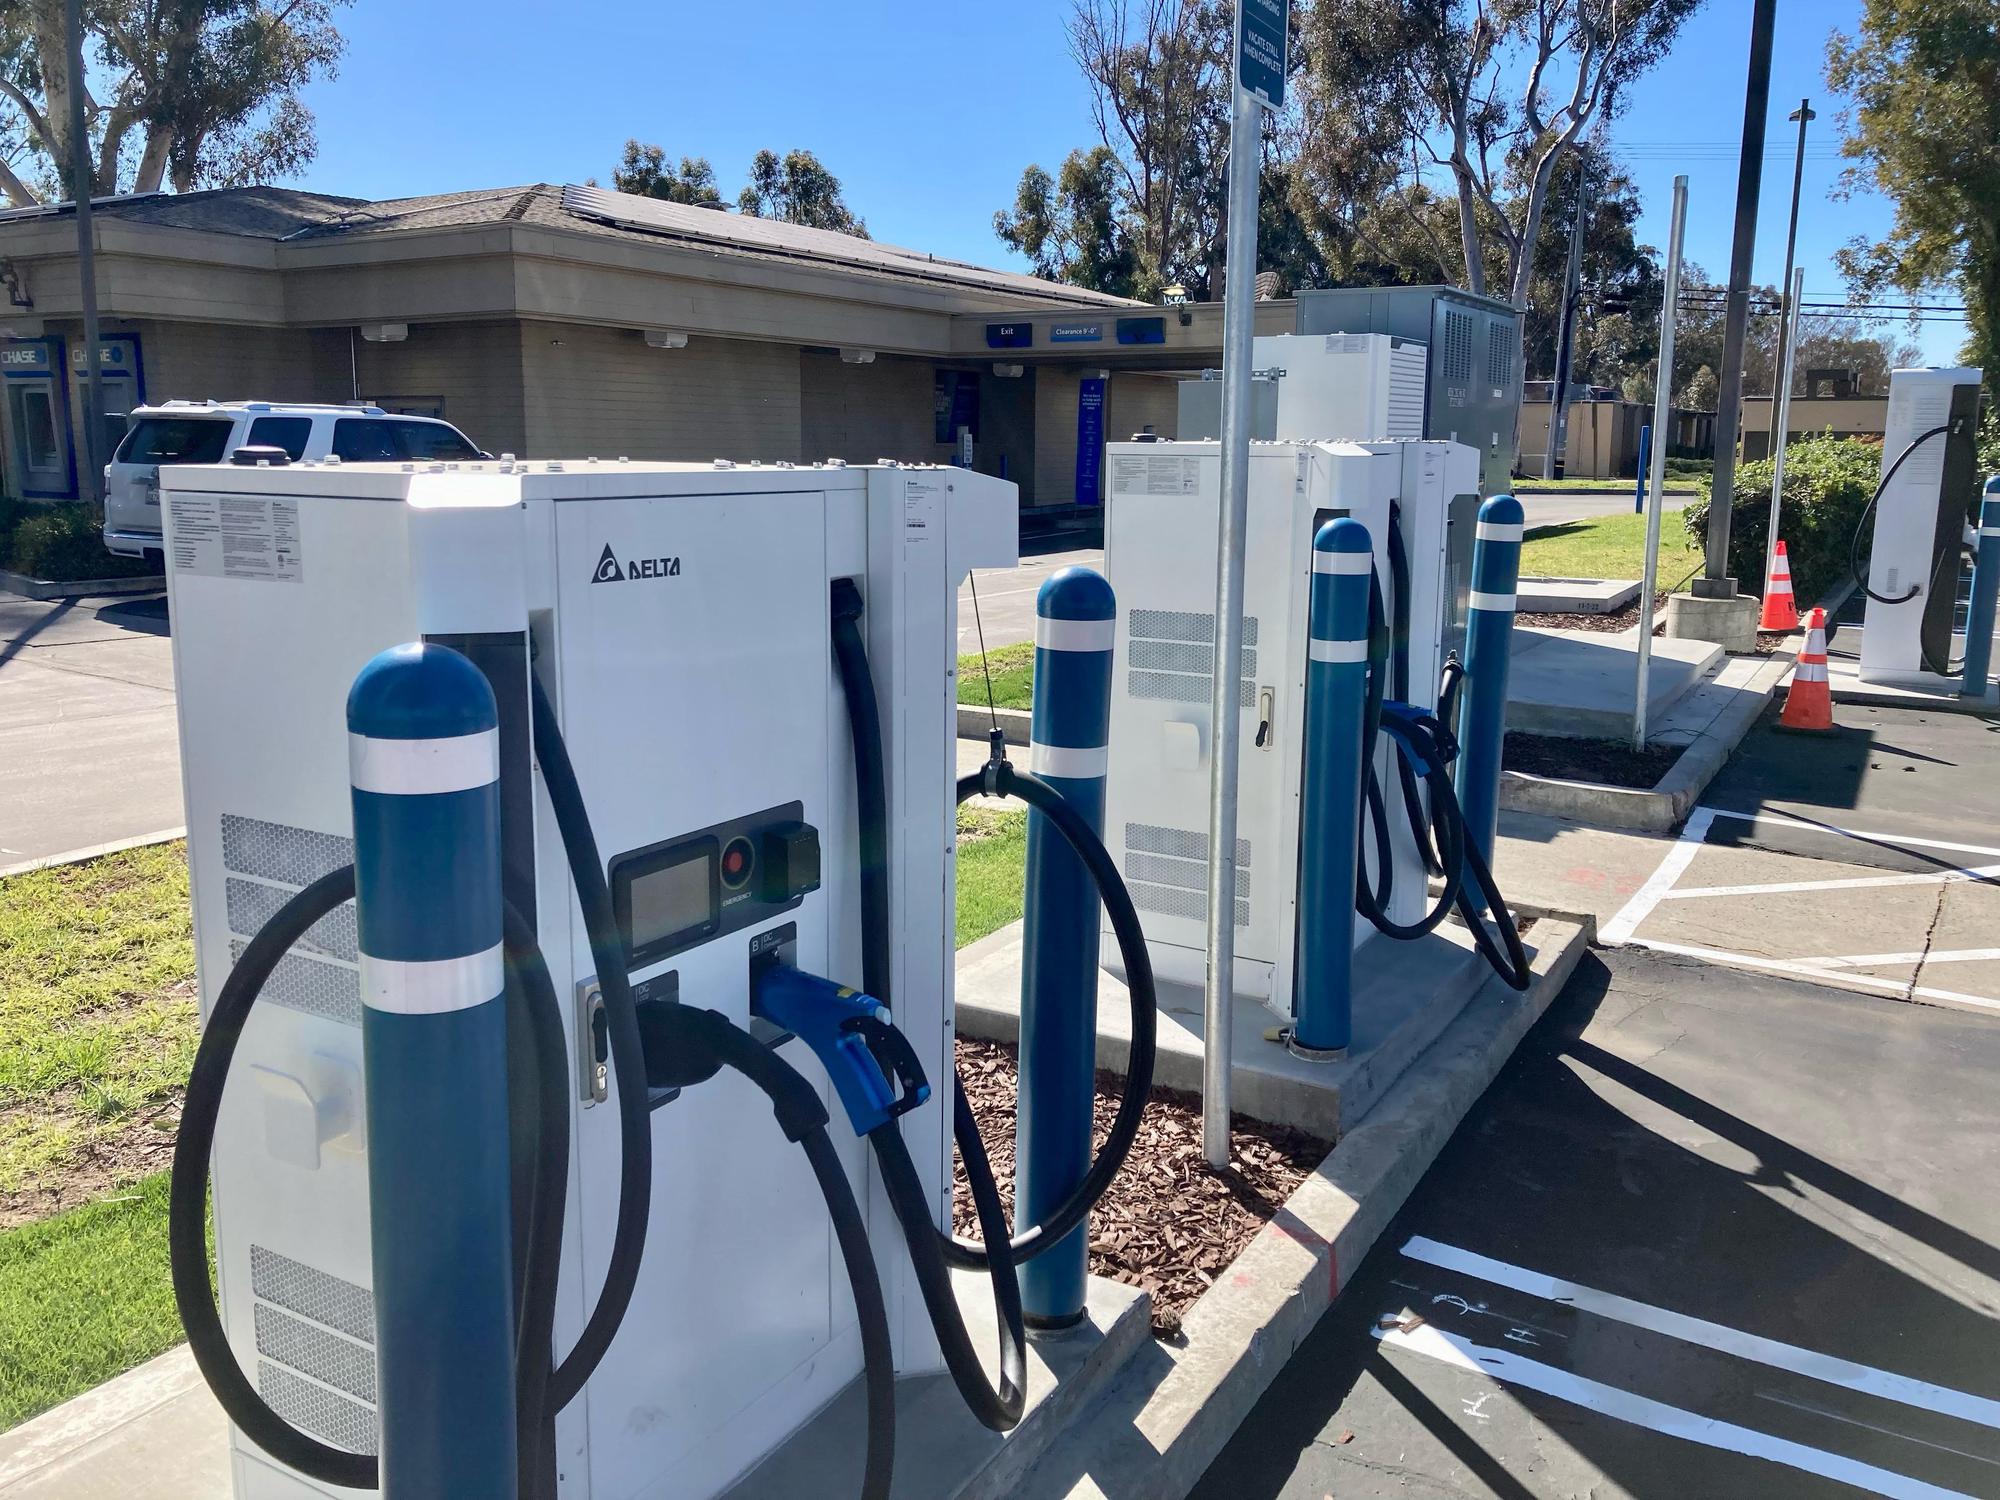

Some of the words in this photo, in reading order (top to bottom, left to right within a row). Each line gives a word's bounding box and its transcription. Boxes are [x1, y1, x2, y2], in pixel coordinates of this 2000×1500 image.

[1247, 29, 1265, 50] VACATE
[1265, 41, 1279, 58] STALL
[1244, 42, 1259, 60] WHEN
[1258, 51, 1281, 75] COMPLETE
[1000, 327, 1014, 335] Exit
[1055, 328, 1082, 336] Clearance
[0, 350, 36, 363] CHASE
[72, 349, 111, 362] CHE
[628, 557, 681, 580] DELTA
[752, 940, 759, 952] B
